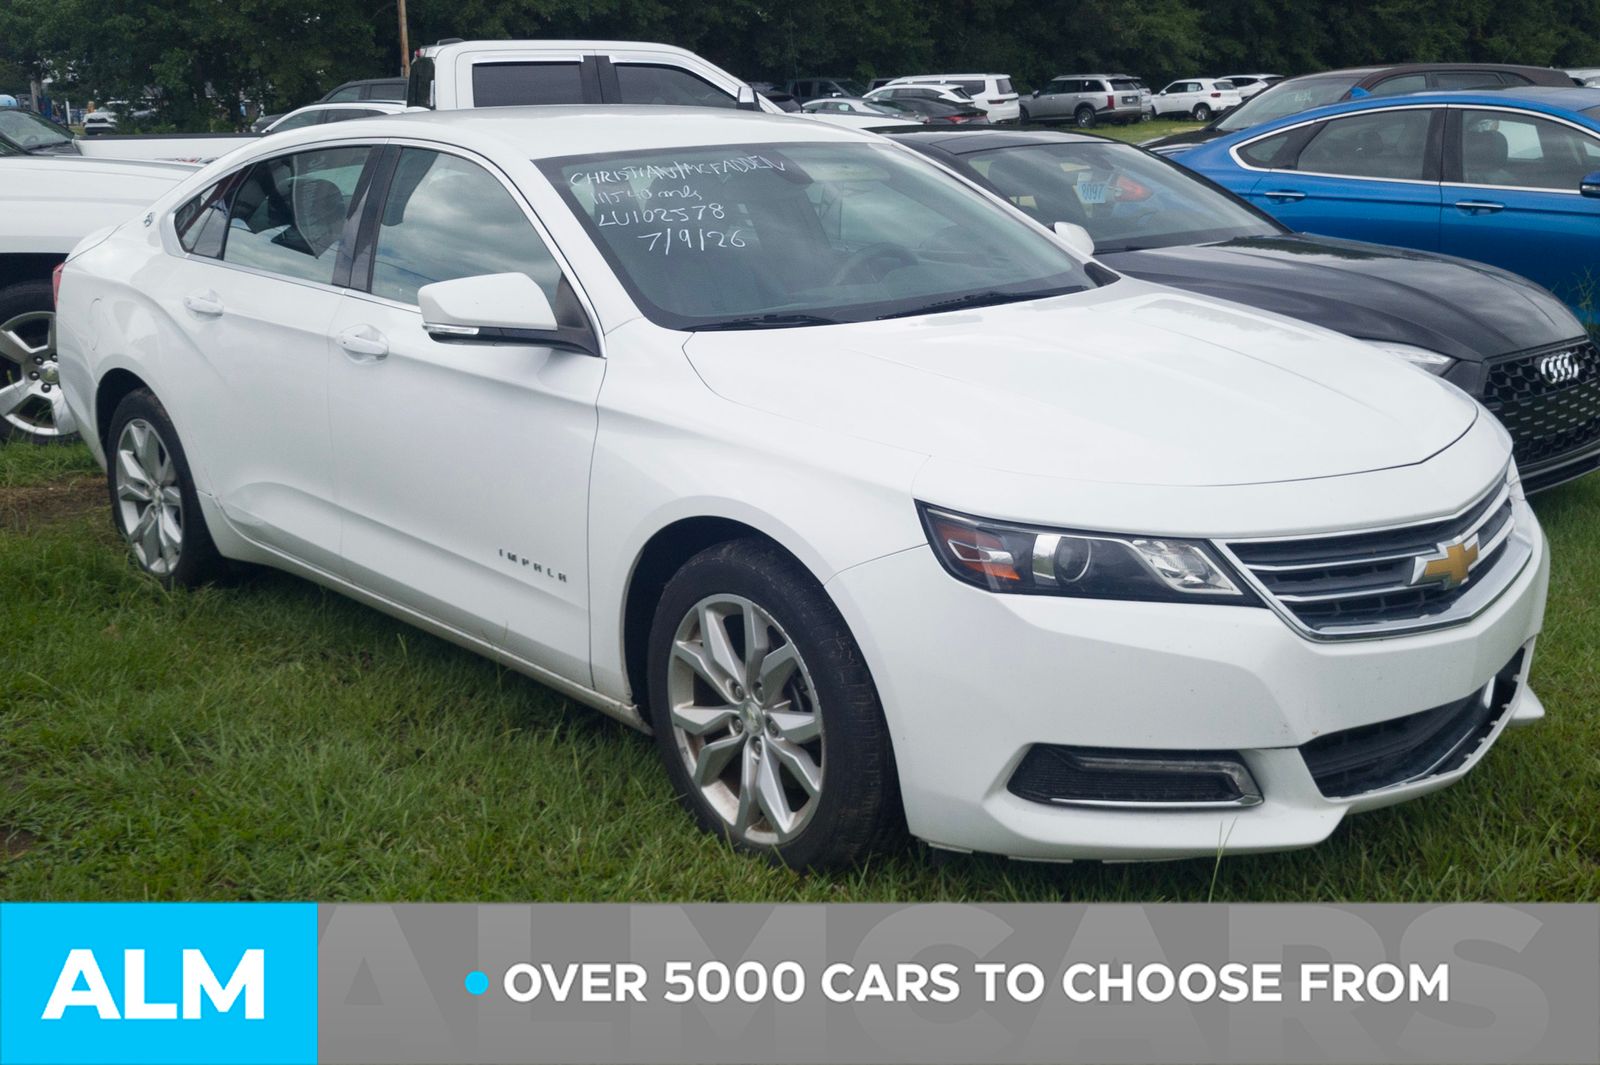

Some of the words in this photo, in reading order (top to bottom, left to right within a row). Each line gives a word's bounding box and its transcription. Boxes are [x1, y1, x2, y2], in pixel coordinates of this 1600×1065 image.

[599, 203, 725, 227] LU102578
[637, 228, 746, 255] 7/9/26
[499, 548, 567, 583] IMPALA
